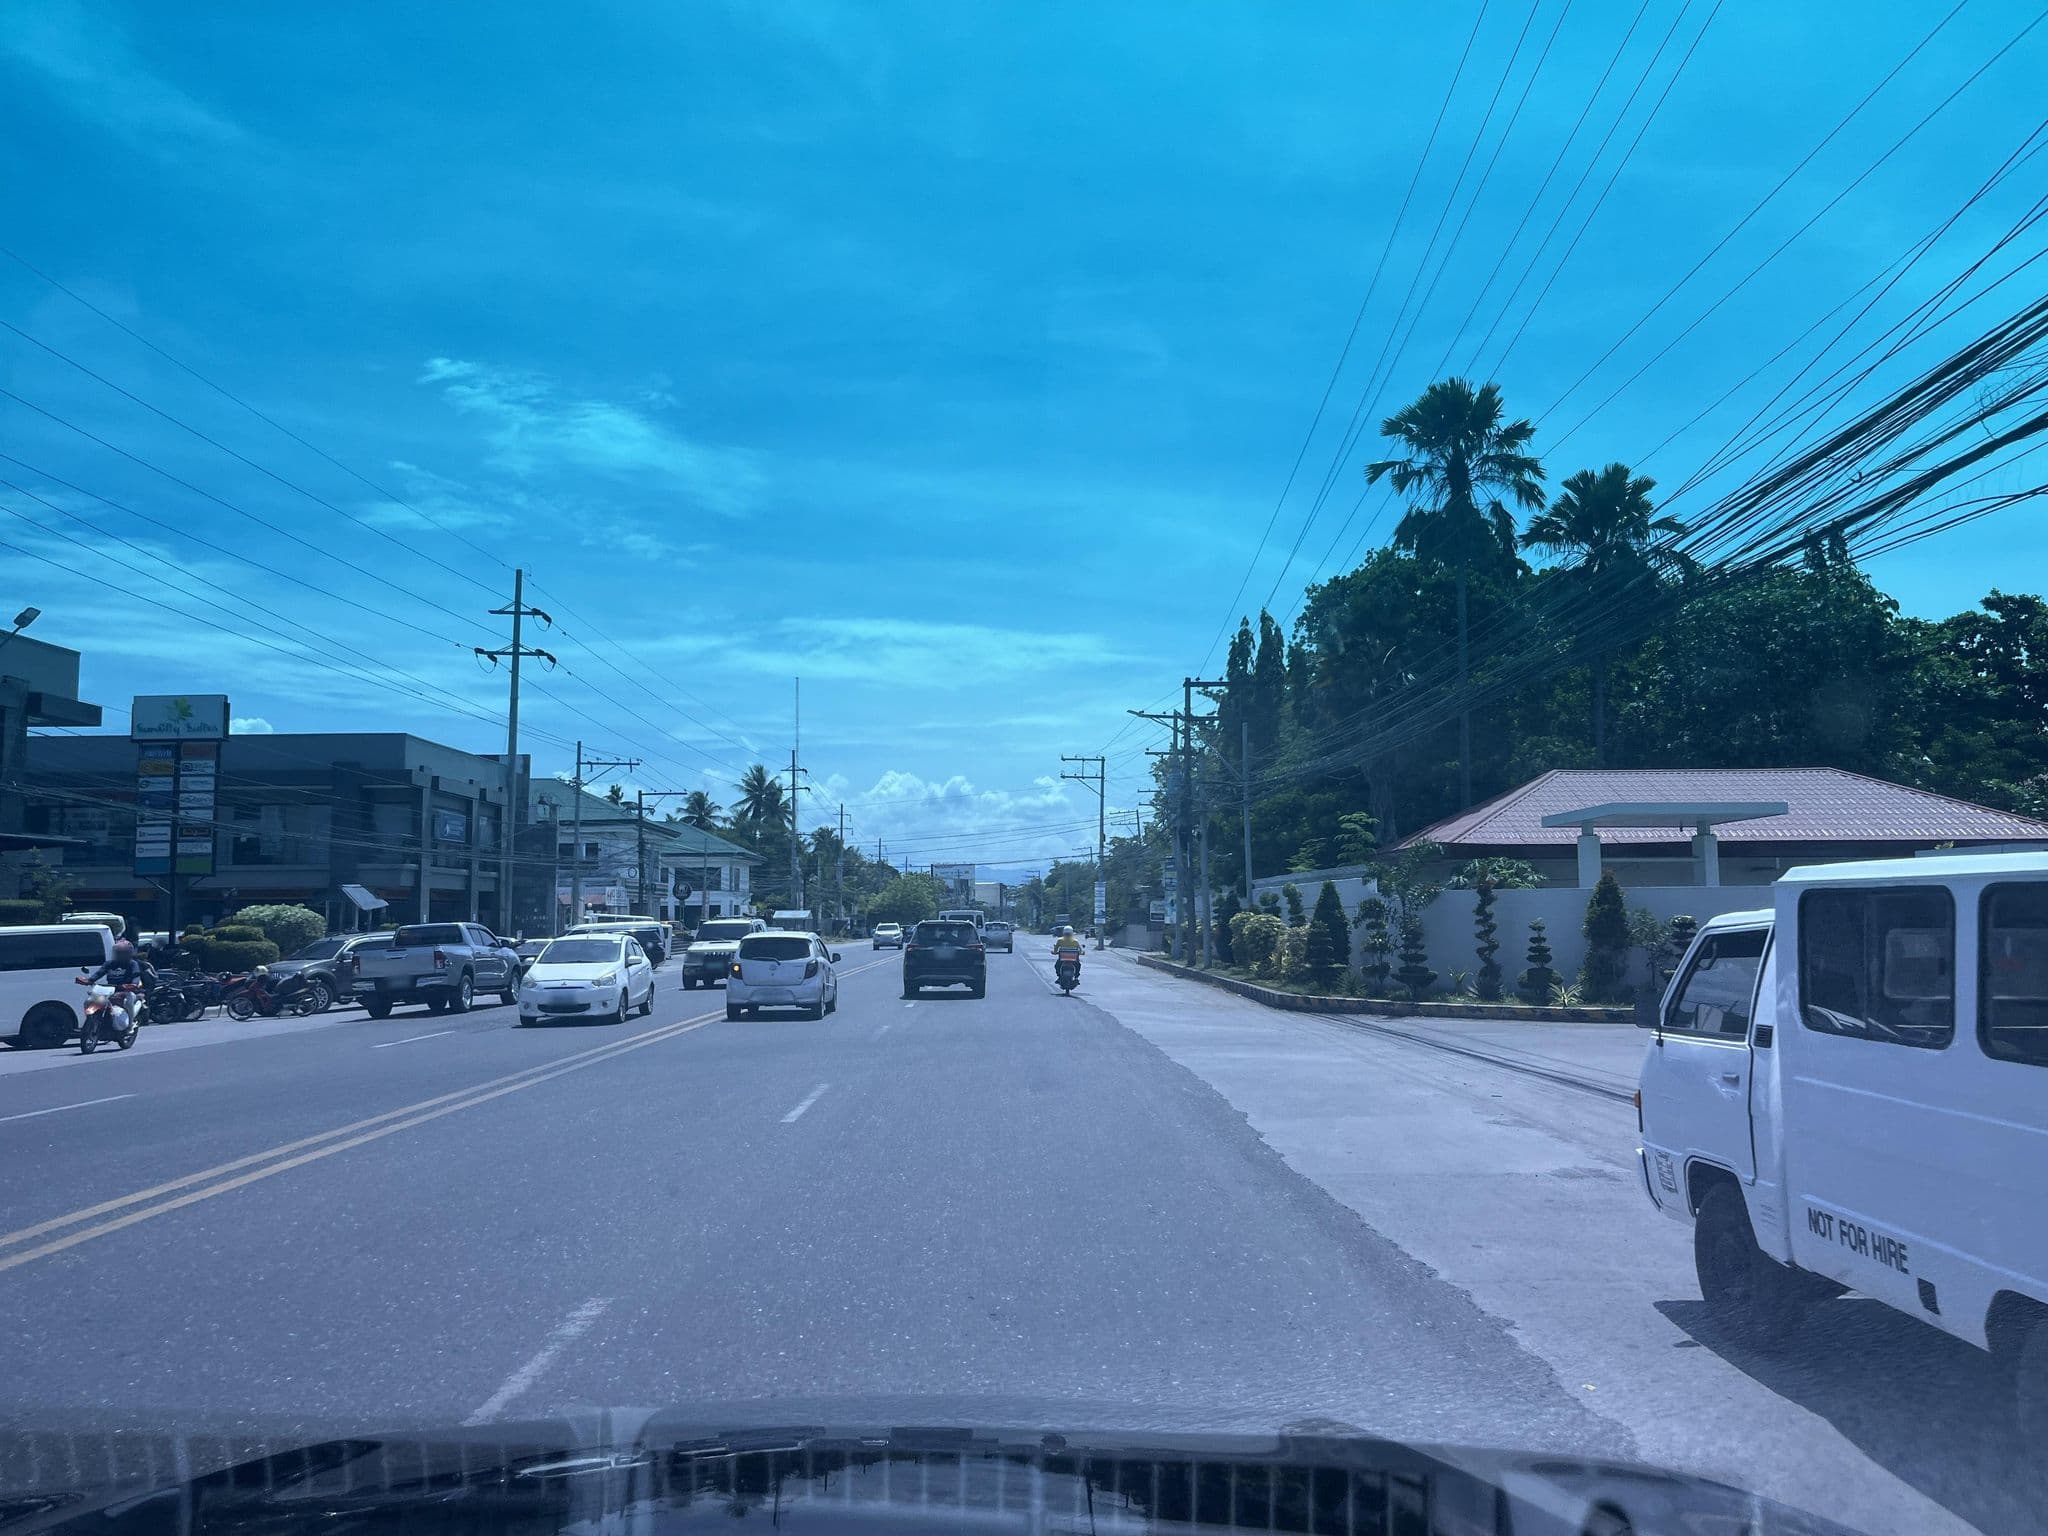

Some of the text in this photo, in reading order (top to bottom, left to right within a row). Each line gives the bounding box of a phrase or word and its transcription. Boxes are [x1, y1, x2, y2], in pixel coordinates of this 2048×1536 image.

[1807, 1207, 1834, 1241] NOT
[1839, 1219, 1869, 1257] FOR
[1871, 1232, 1910, 1275] HIRE
